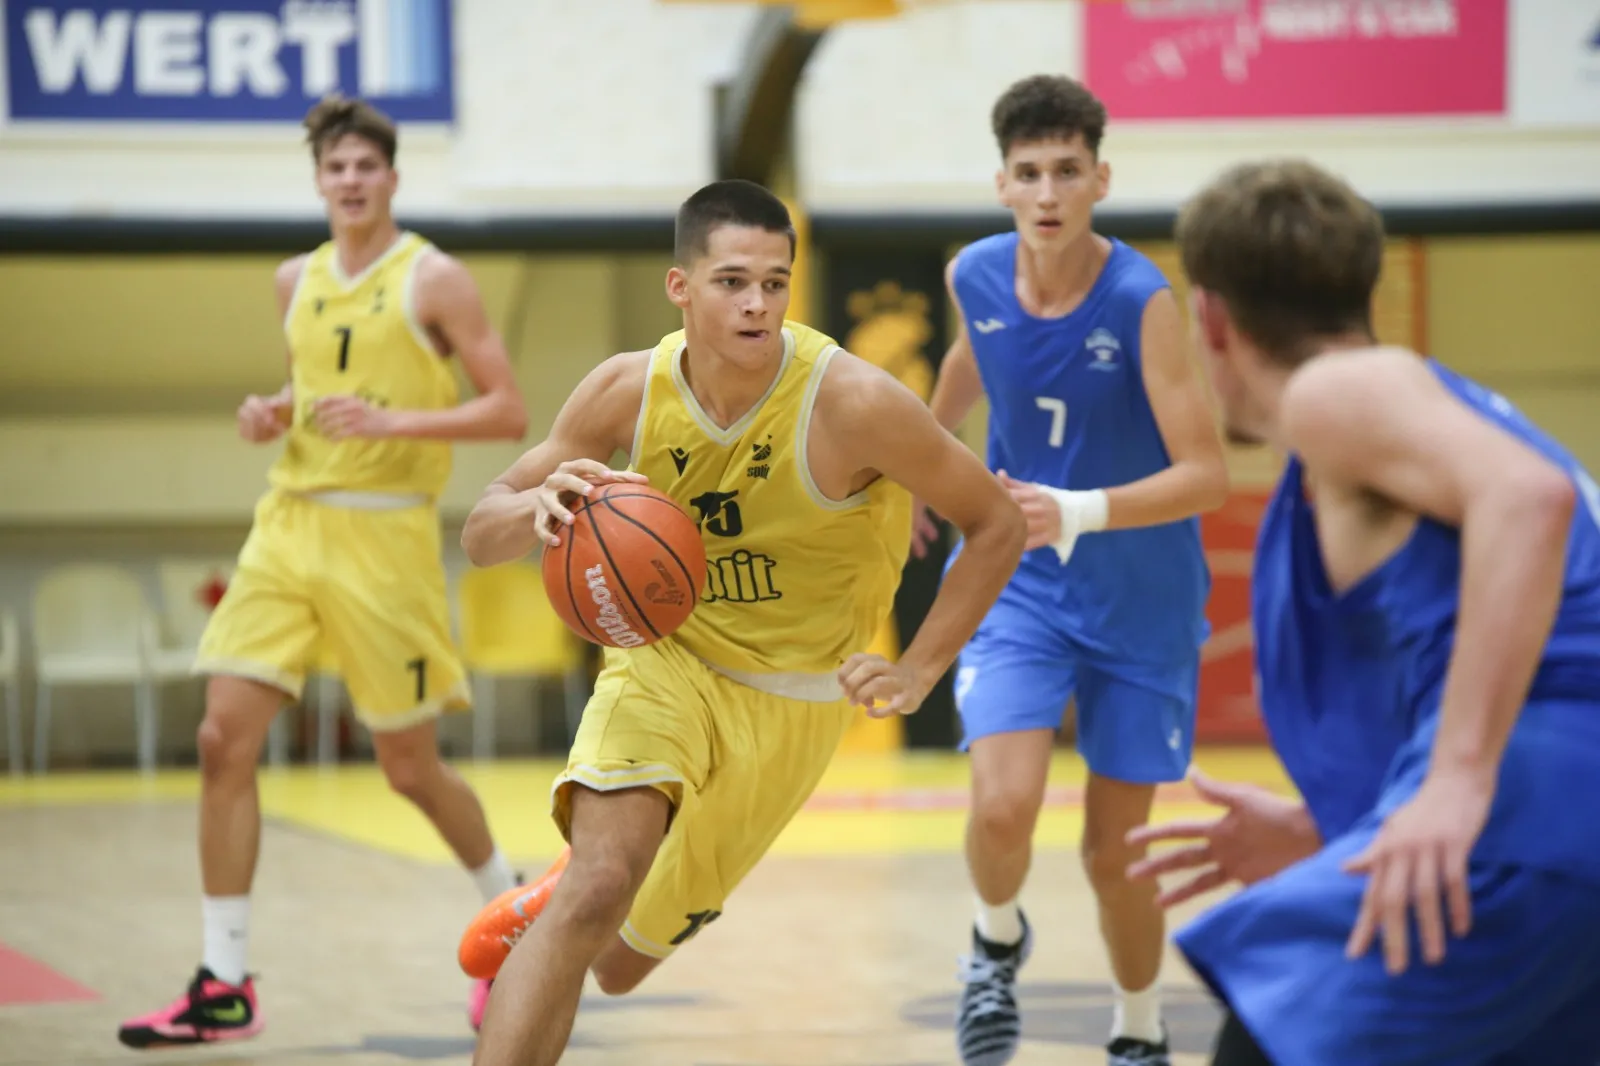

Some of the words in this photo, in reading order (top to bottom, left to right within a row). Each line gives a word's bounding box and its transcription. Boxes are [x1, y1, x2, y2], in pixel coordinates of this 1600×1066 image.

[23, 8, 356, 97] WERT
[333, 325, 353, 374] 1
[1034, 396, 1068, 448] 7
[584, 563, 646, 648] Wilson
[405, 657, 427, 703] 1
